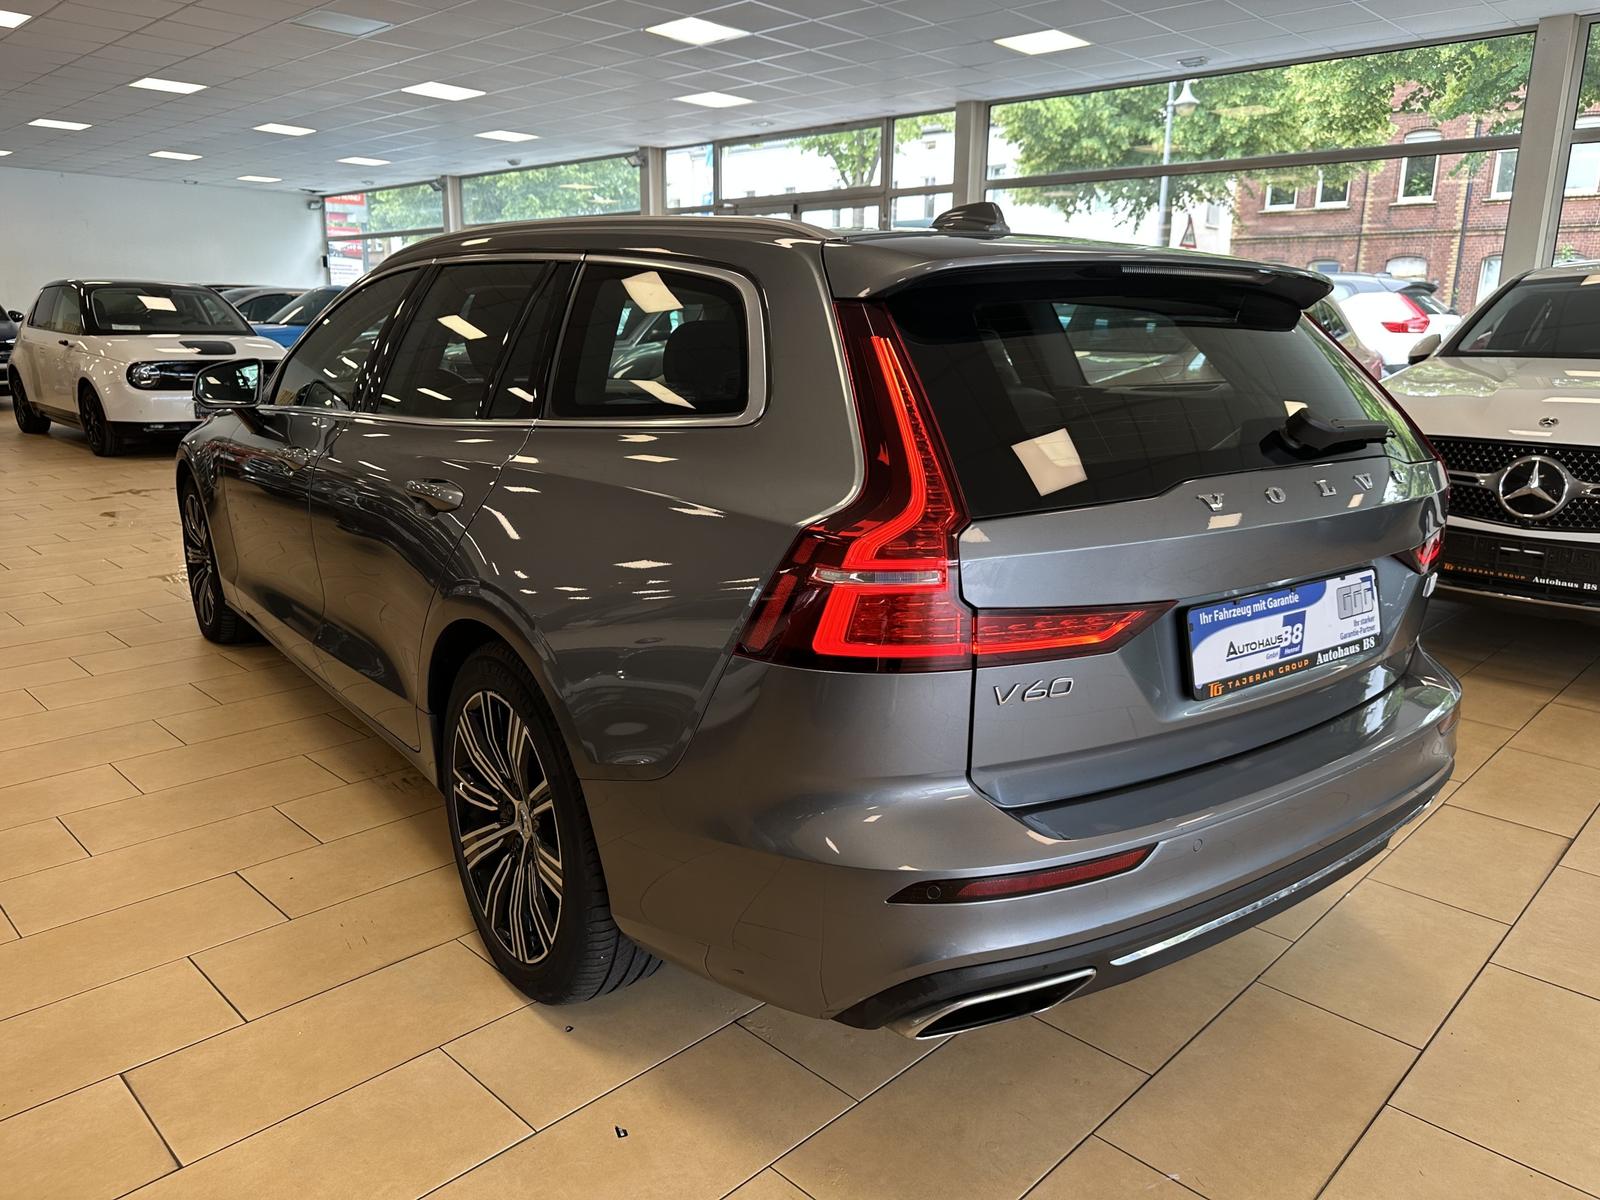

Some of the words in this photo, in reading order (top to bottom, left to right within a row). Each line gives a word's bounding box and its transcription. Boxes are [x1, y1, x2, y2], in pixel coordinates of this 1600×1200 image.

[1197, 467, 1405, 512] VOLVO
[1532, 575, 1579, 589] Autohaus
[1199, 612, 1213, 625] Ihr
[1214, 604, 1252, 622] Fahrzeug
[1253, 599, 1267, 611] mit
[1267, 592, 1300, 608] Garantie
[1281, 623, 1303, 647] B8
[1316, 643, 1360, 665] Autohaus
[1228, 670, 1274, 689] TAJERAN
[1279, 659, 1309, 674] GROUP
[994, 677, 1074, 706] V60
